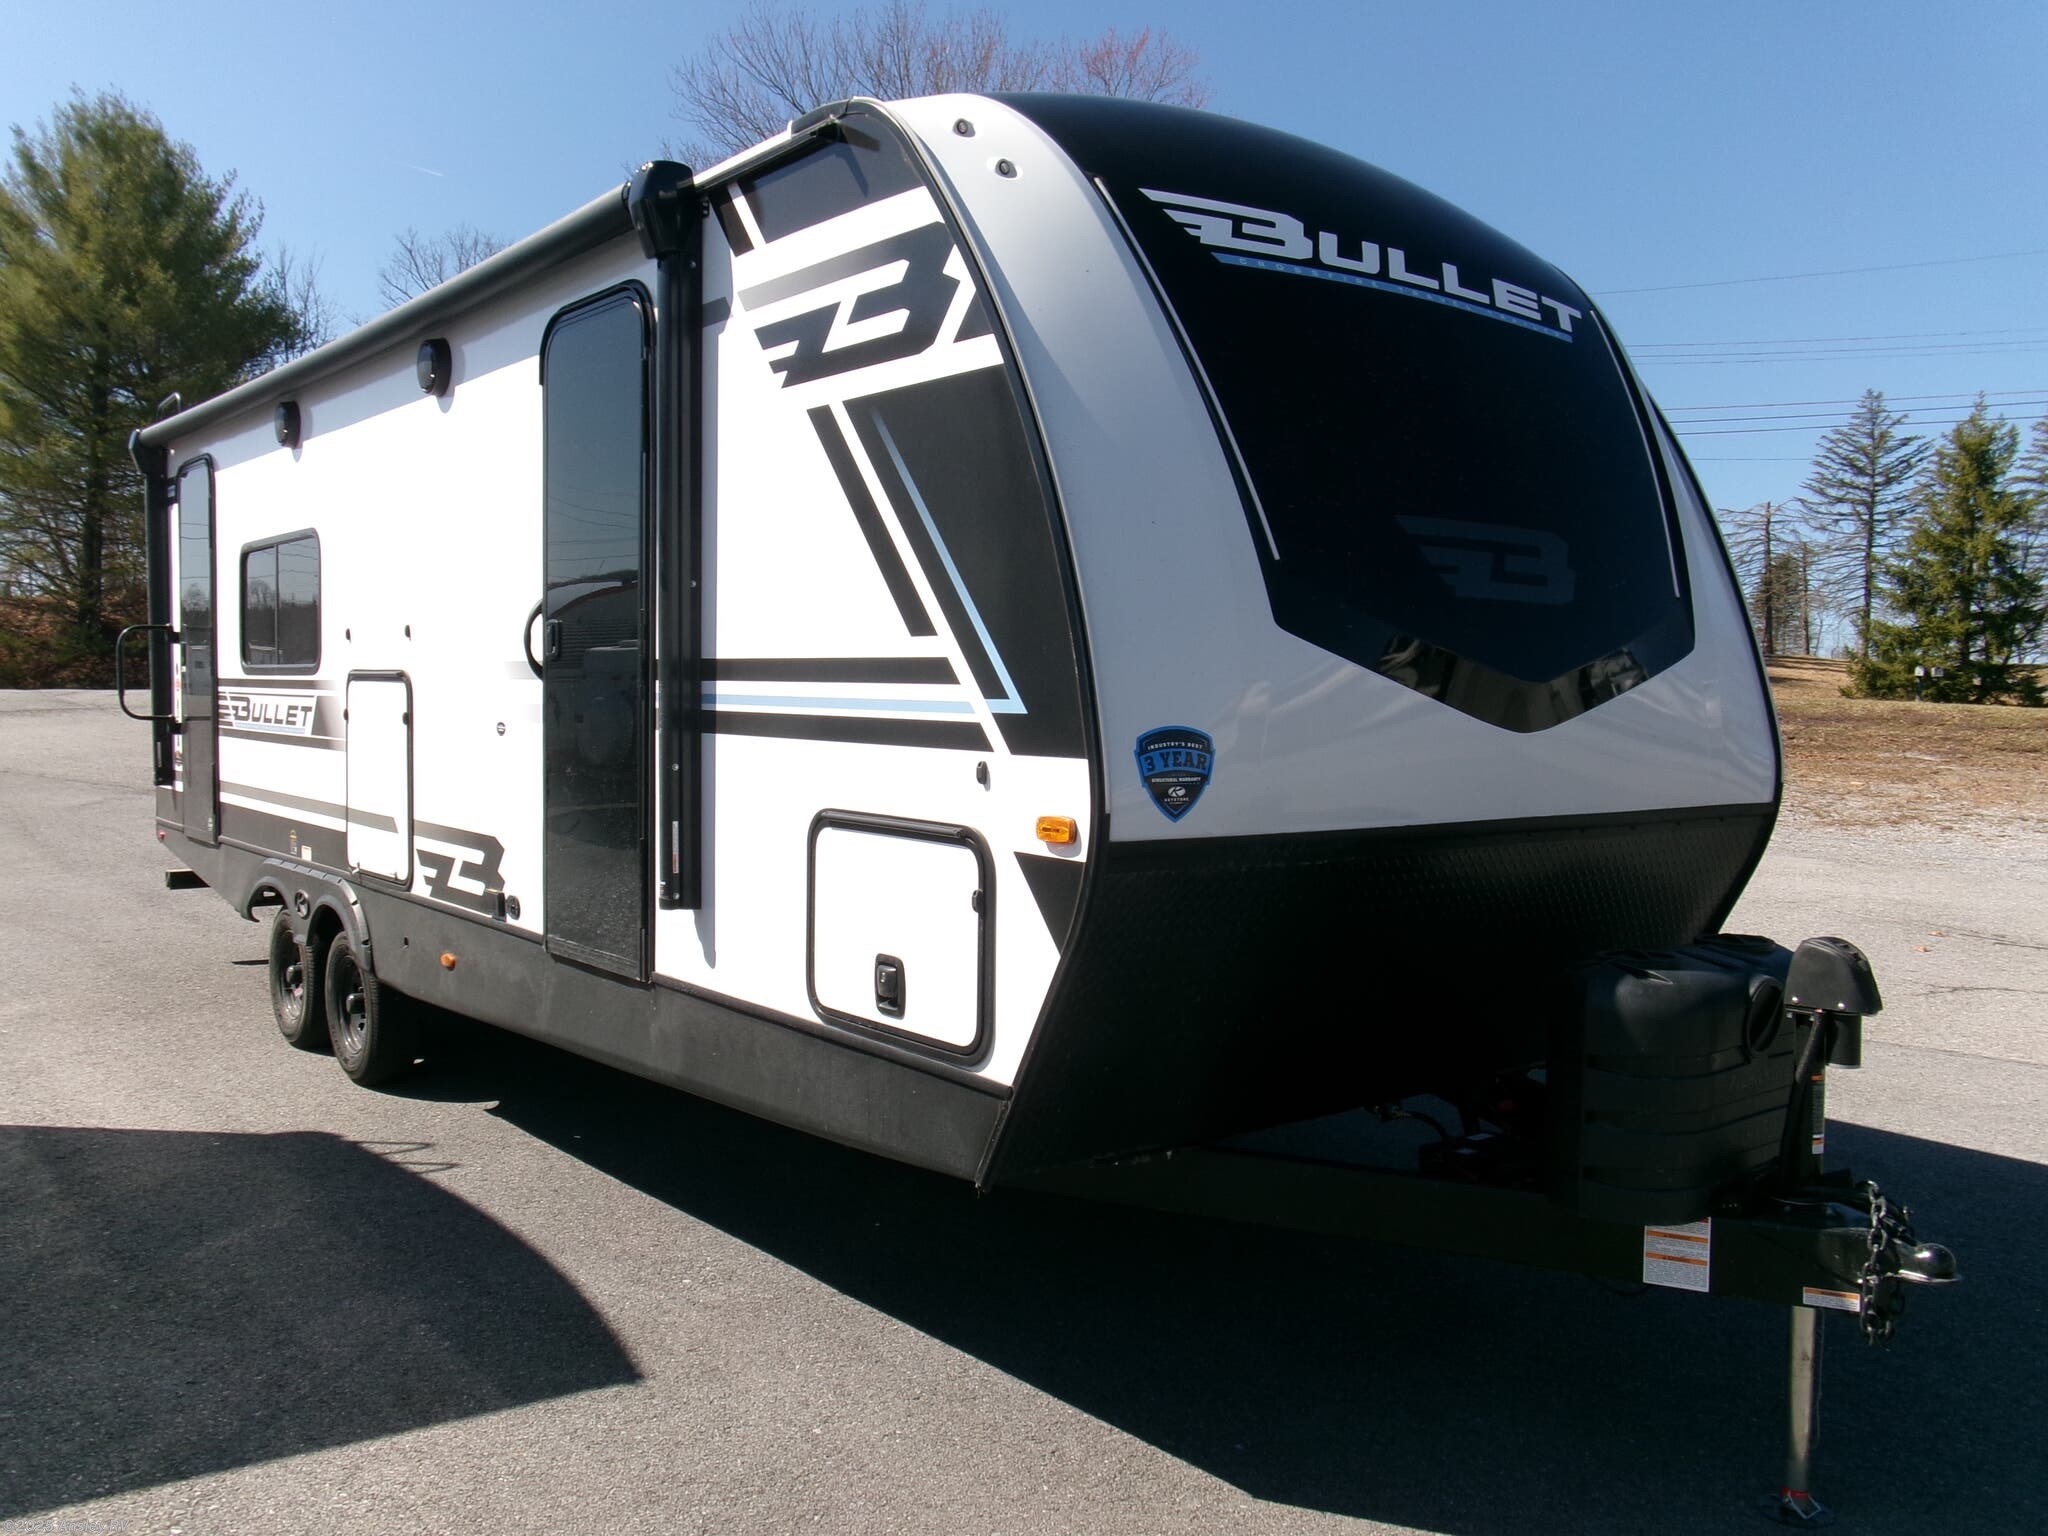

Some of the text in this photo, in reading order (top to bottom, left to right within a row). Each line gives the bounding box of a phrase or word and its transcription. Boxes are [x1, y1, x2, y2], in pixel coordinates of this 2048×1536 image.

[1138, 187, 1581, 333] BULLET
[229, 696, 312, 727] BULLET
[1160, 751, 1206, 770] YEAR
